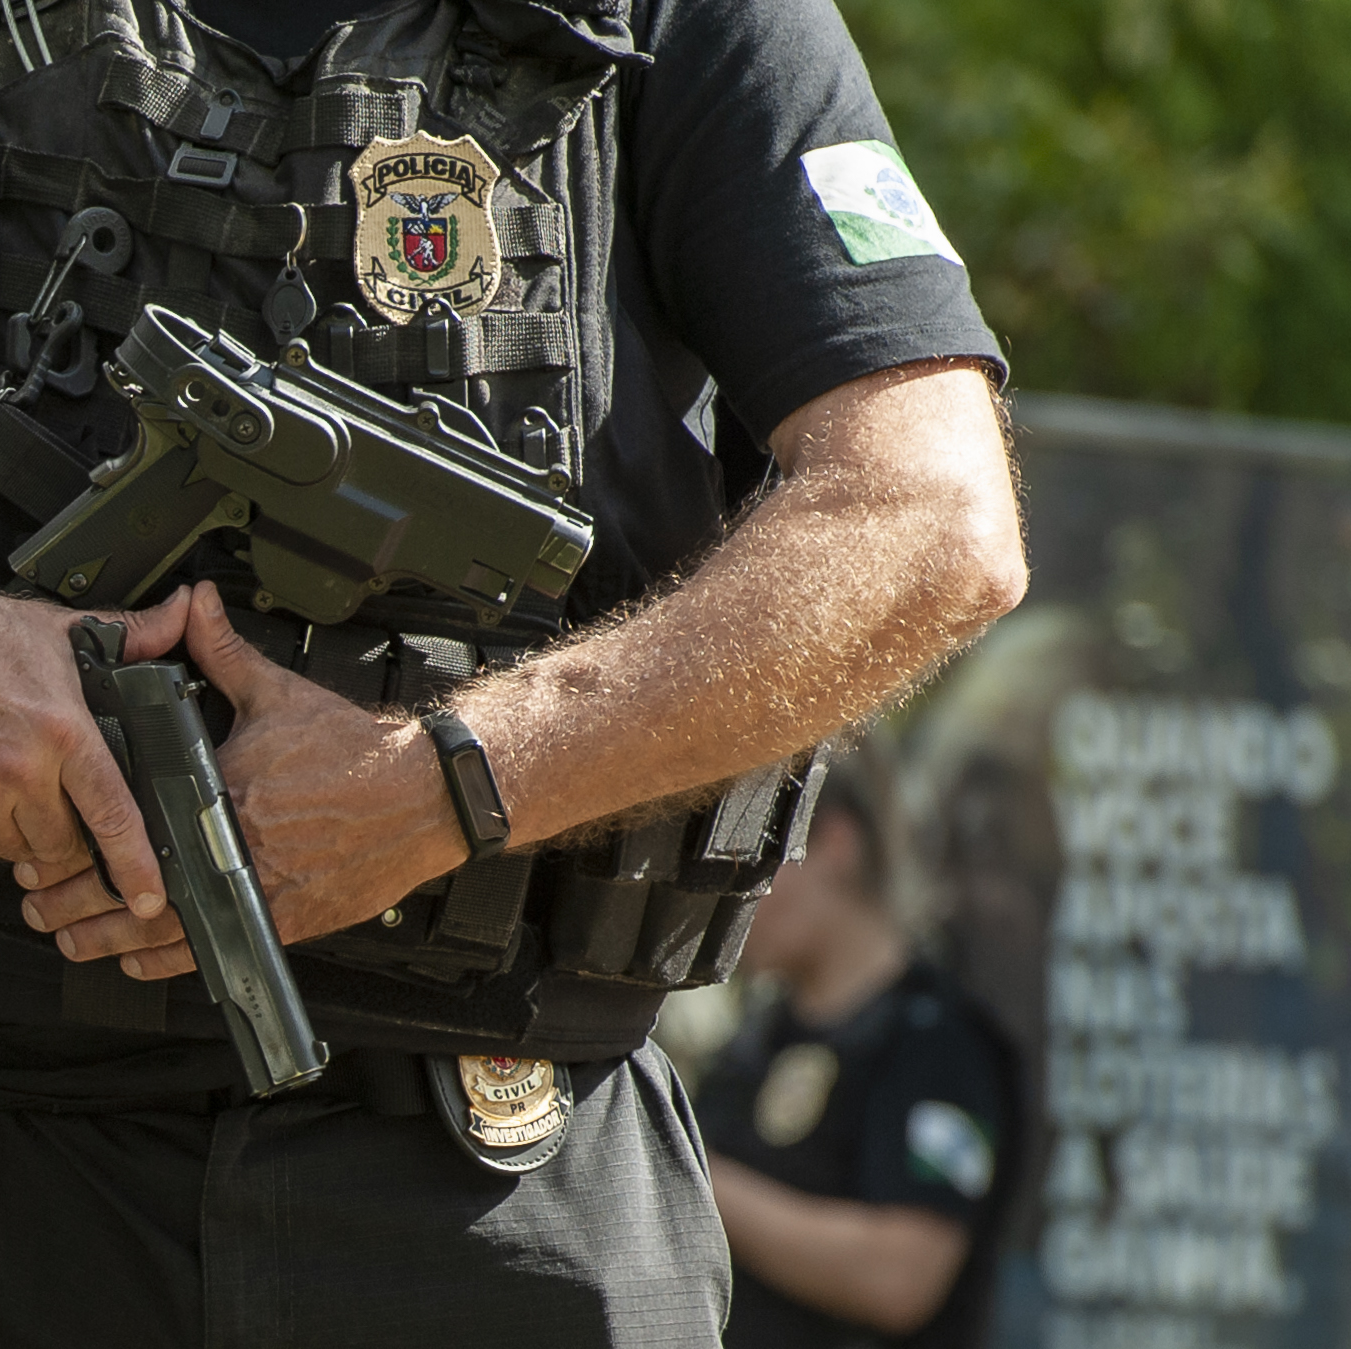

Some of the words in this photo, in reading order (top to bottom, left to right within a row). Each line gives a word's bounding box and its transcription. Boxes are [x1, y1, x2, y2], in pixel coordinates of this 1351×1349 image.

[377, 155, 473, 190] POLÍCIA
[492, 1079, 537, 1101] CIVIL
[509, 1100, 527, 1115] PR
[483, 1109, 562, 1144] INVESTIGADOR
